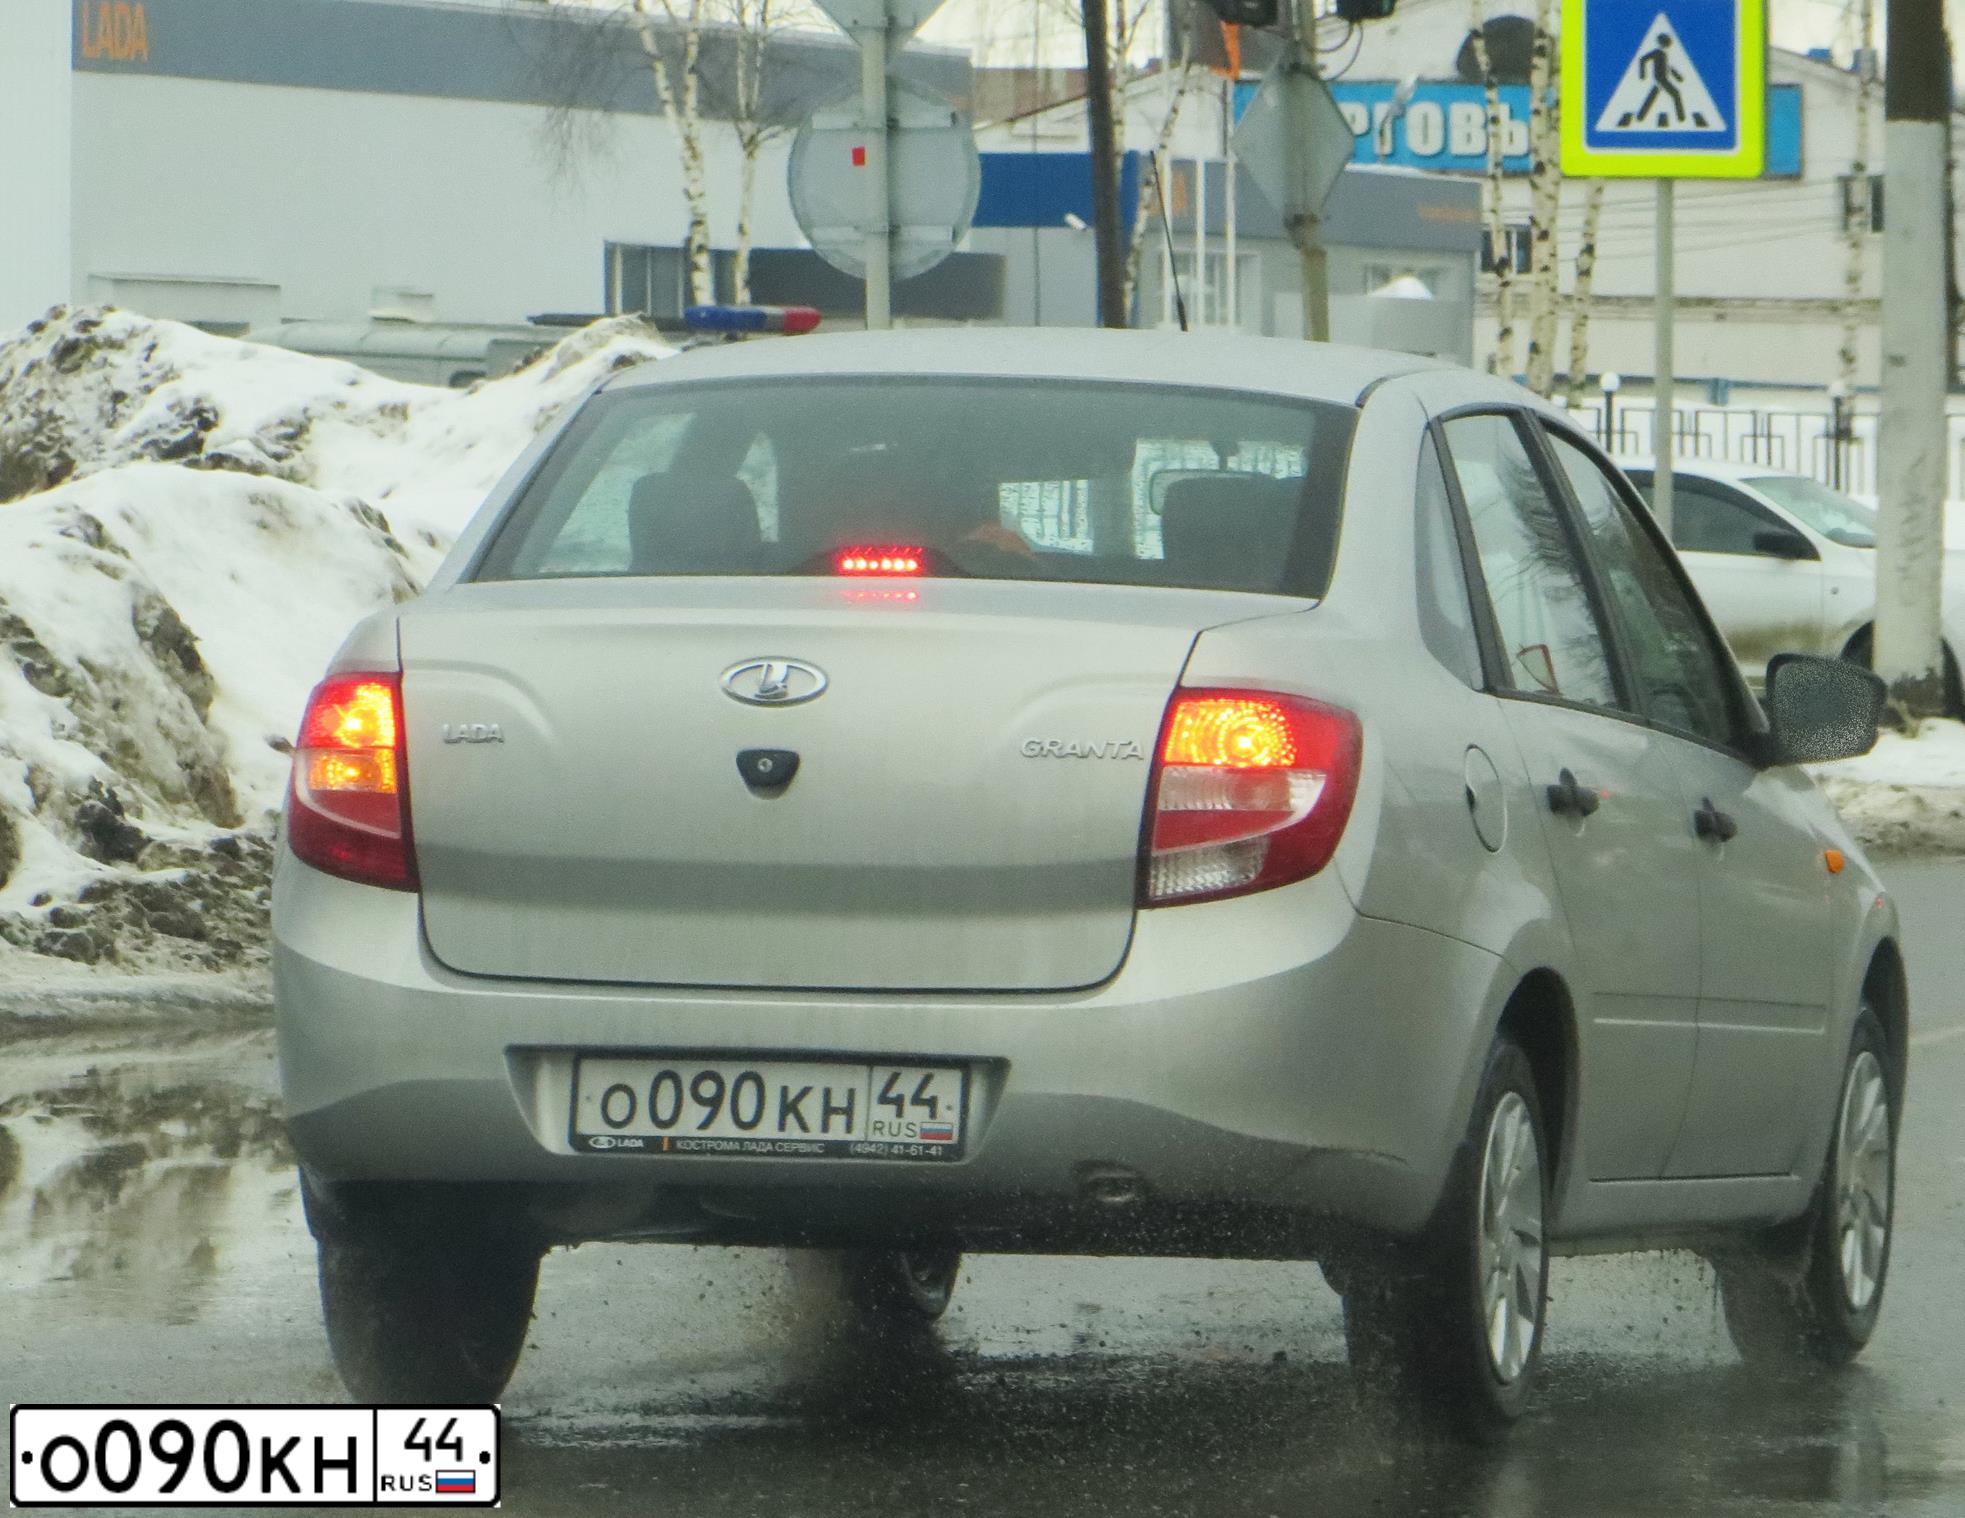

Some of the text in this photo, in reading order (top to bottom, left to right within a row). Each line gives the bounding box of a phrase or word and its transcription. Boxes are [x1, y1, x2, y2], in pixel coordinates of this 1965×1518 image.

[81, 1, 148, 61] LADA
[443, 723, 504, 744] LADA
[1021, 738, 1145, 760] GRANTA
[876, 1072, 937, 1120] 44
[873, 1121, 917, 1138] RUS
[618, 1138, 645, 1148] LADA
[676, 1140, 825, 1153] КОСТРОМА ЛАДА СЕРВИС
